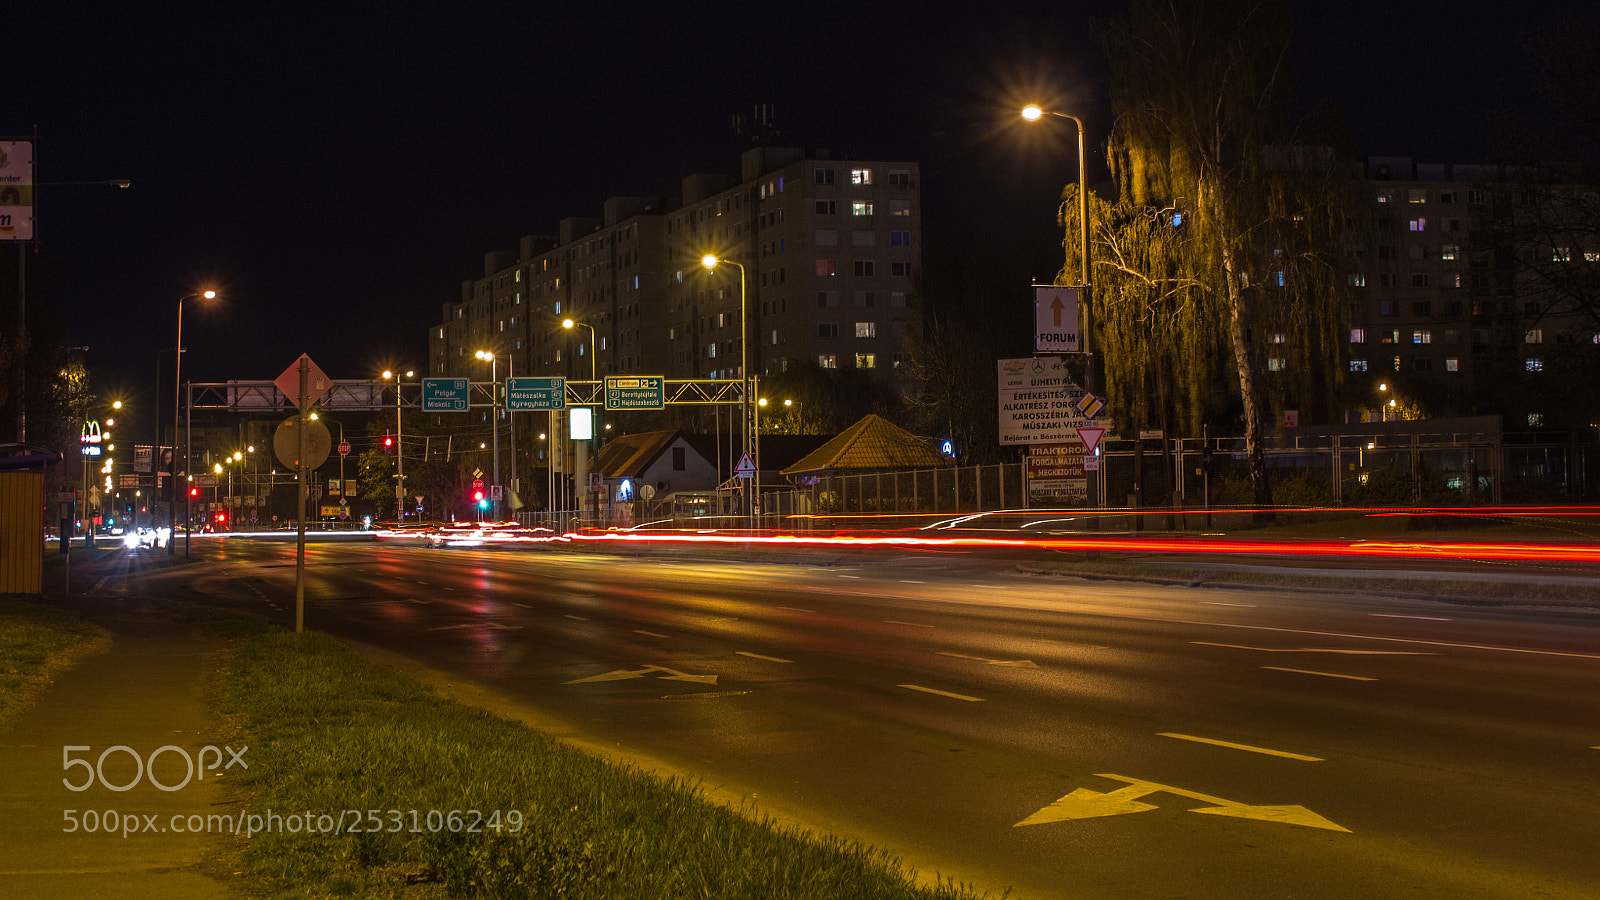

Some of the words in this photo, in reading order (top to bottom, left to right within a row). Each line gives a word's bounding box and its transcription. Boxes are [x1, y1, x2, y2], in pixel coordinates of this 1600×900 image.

[1040, 333, 1076, 343] FORUM
[1003, 401, 1049, 411] ALKATRÉSZ
[1012, 410, 1070, 421] KAROSSZÉRIA
